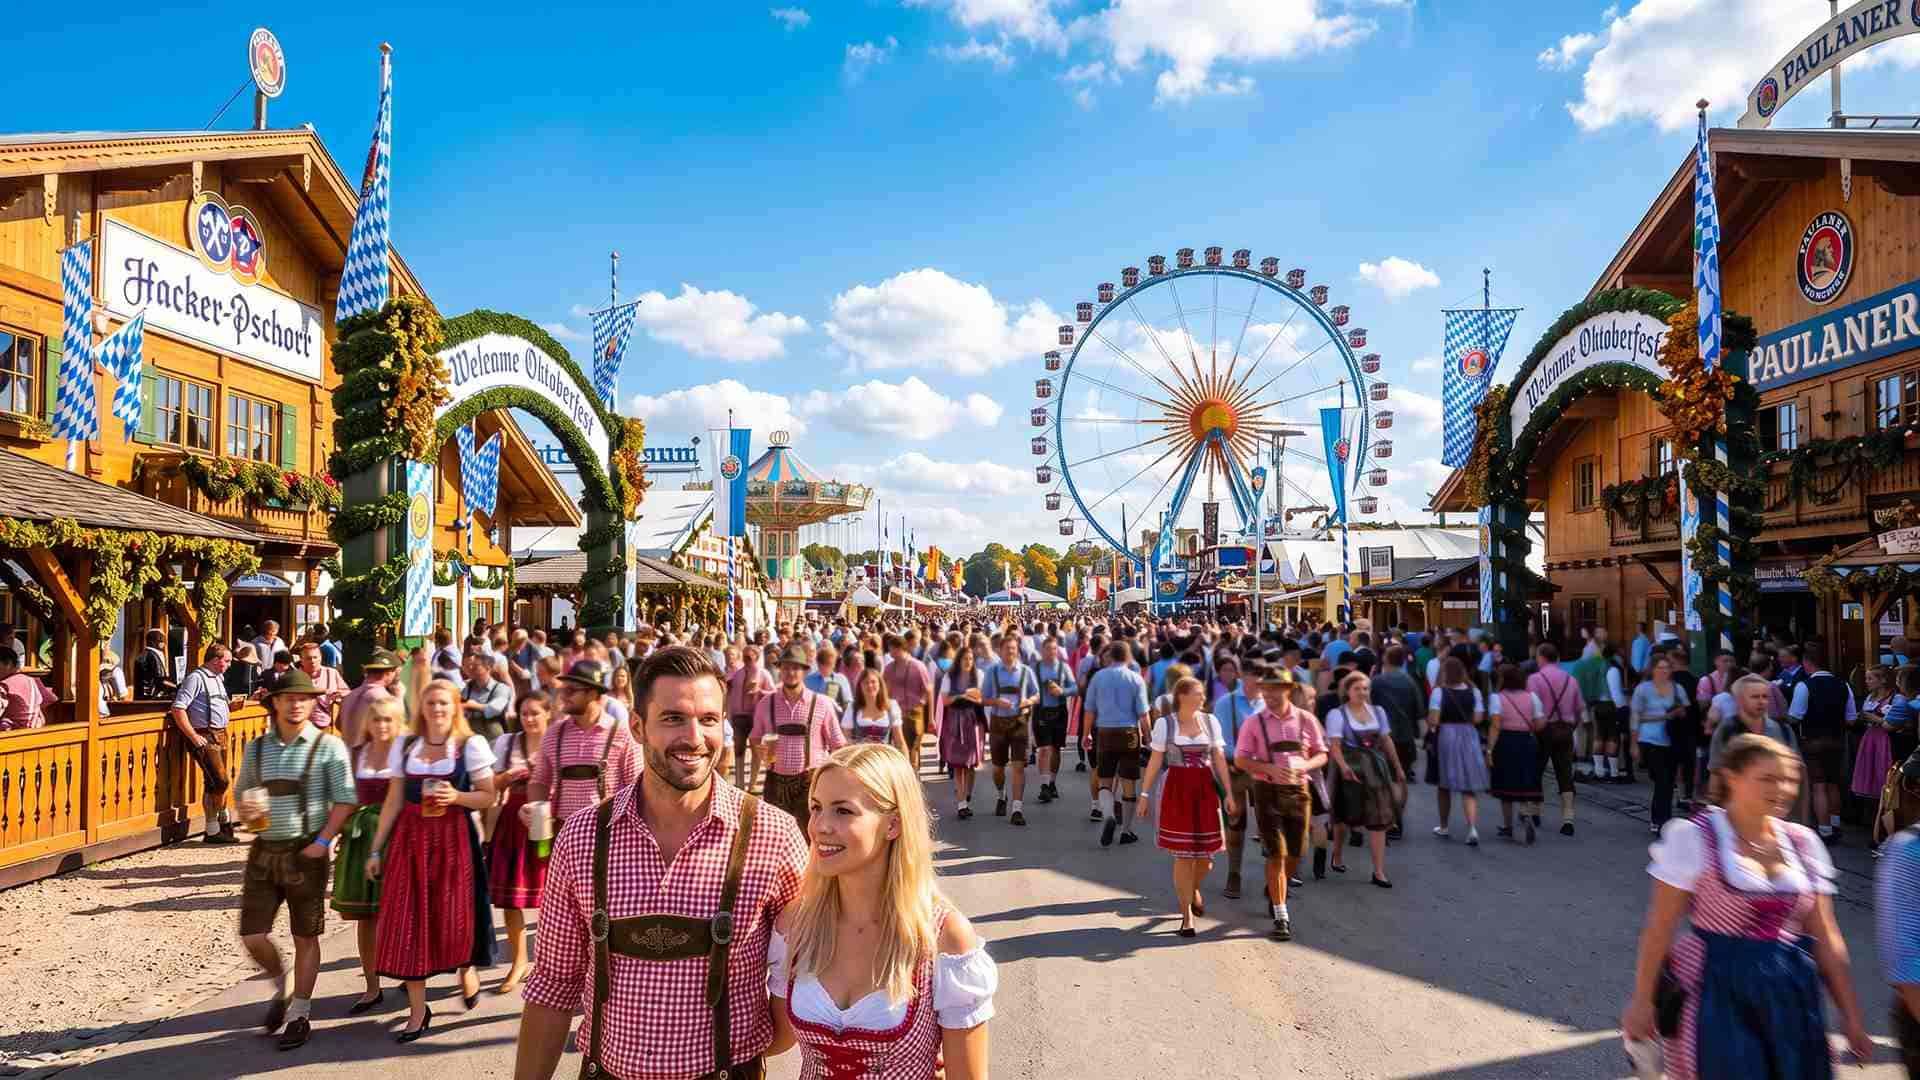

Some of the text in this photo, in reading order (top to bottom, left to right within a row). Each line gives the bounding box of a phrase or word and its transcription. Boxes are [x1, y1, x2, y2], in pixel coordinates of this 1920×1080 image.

[1781, 0, 1902, 91] PAULANER
[123, 257, 312, 358] Hacker-Pschorr
[1747, 292, 1920, 385] PAULANER
